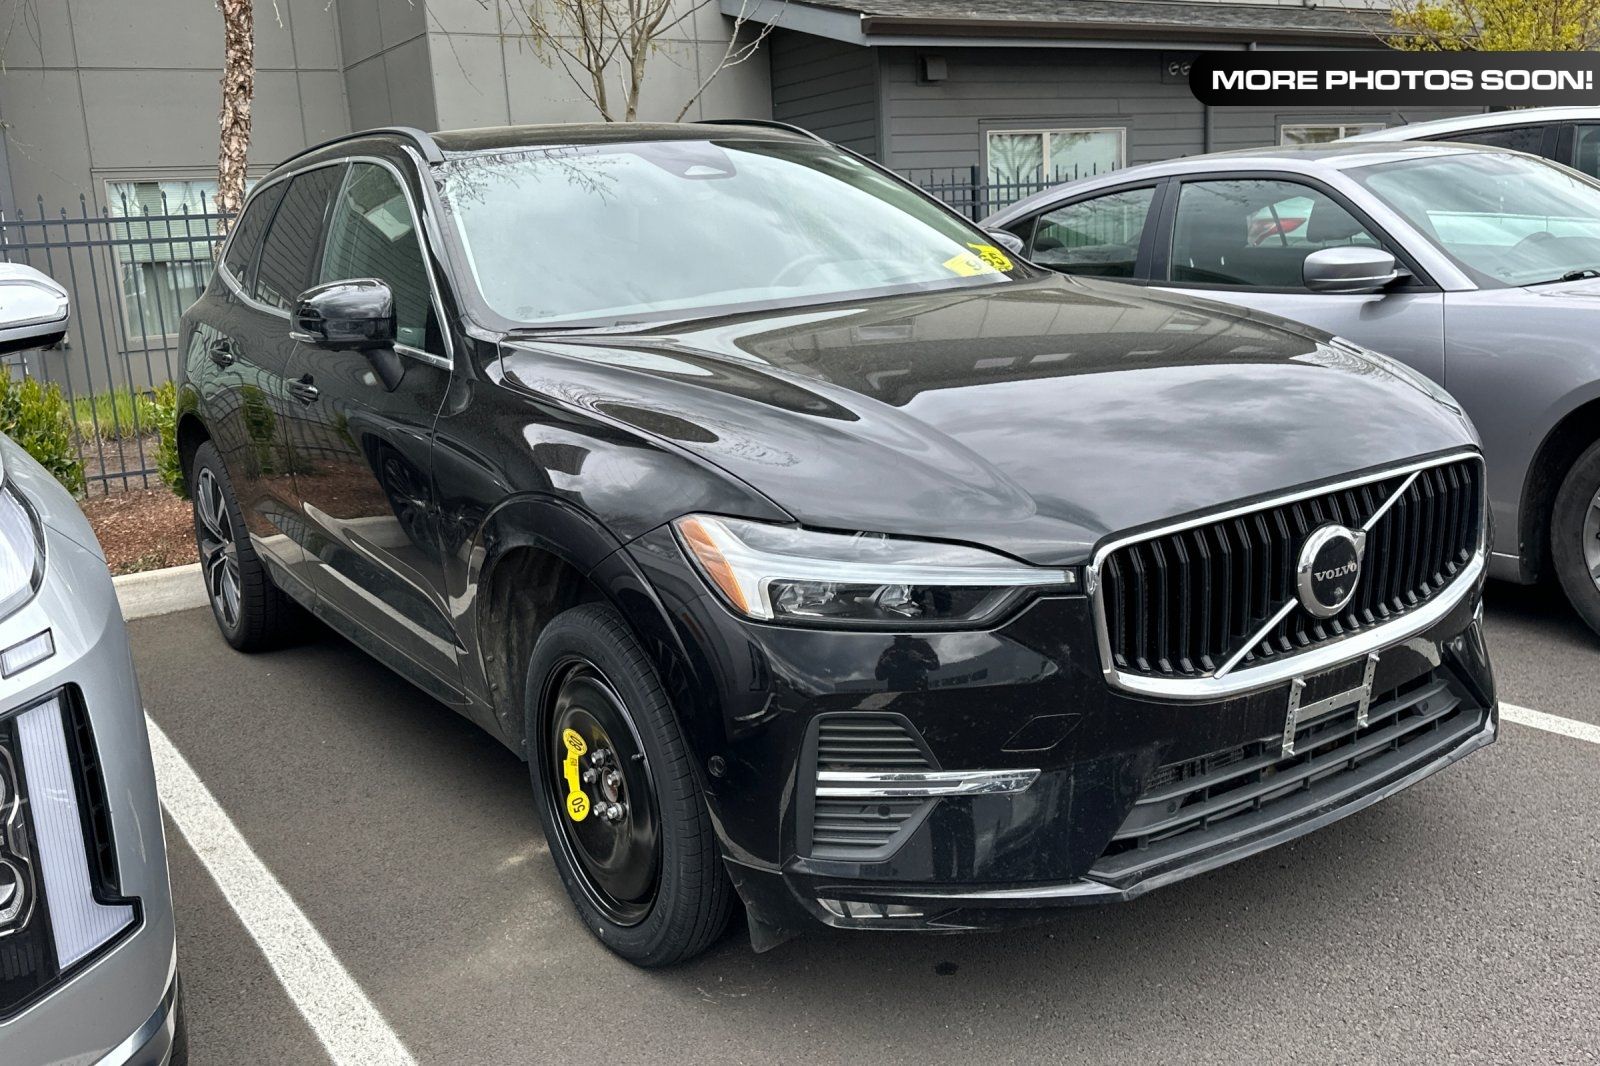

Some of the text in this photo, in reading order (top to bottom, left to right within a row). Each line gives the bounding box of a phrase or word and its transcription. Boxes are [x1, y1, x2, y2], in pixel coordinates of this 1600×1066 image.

[1314, 562, 1357, 582] VOLVO
[569, 735, 583, 752] 80
[572, 797, 585, 813] 50
